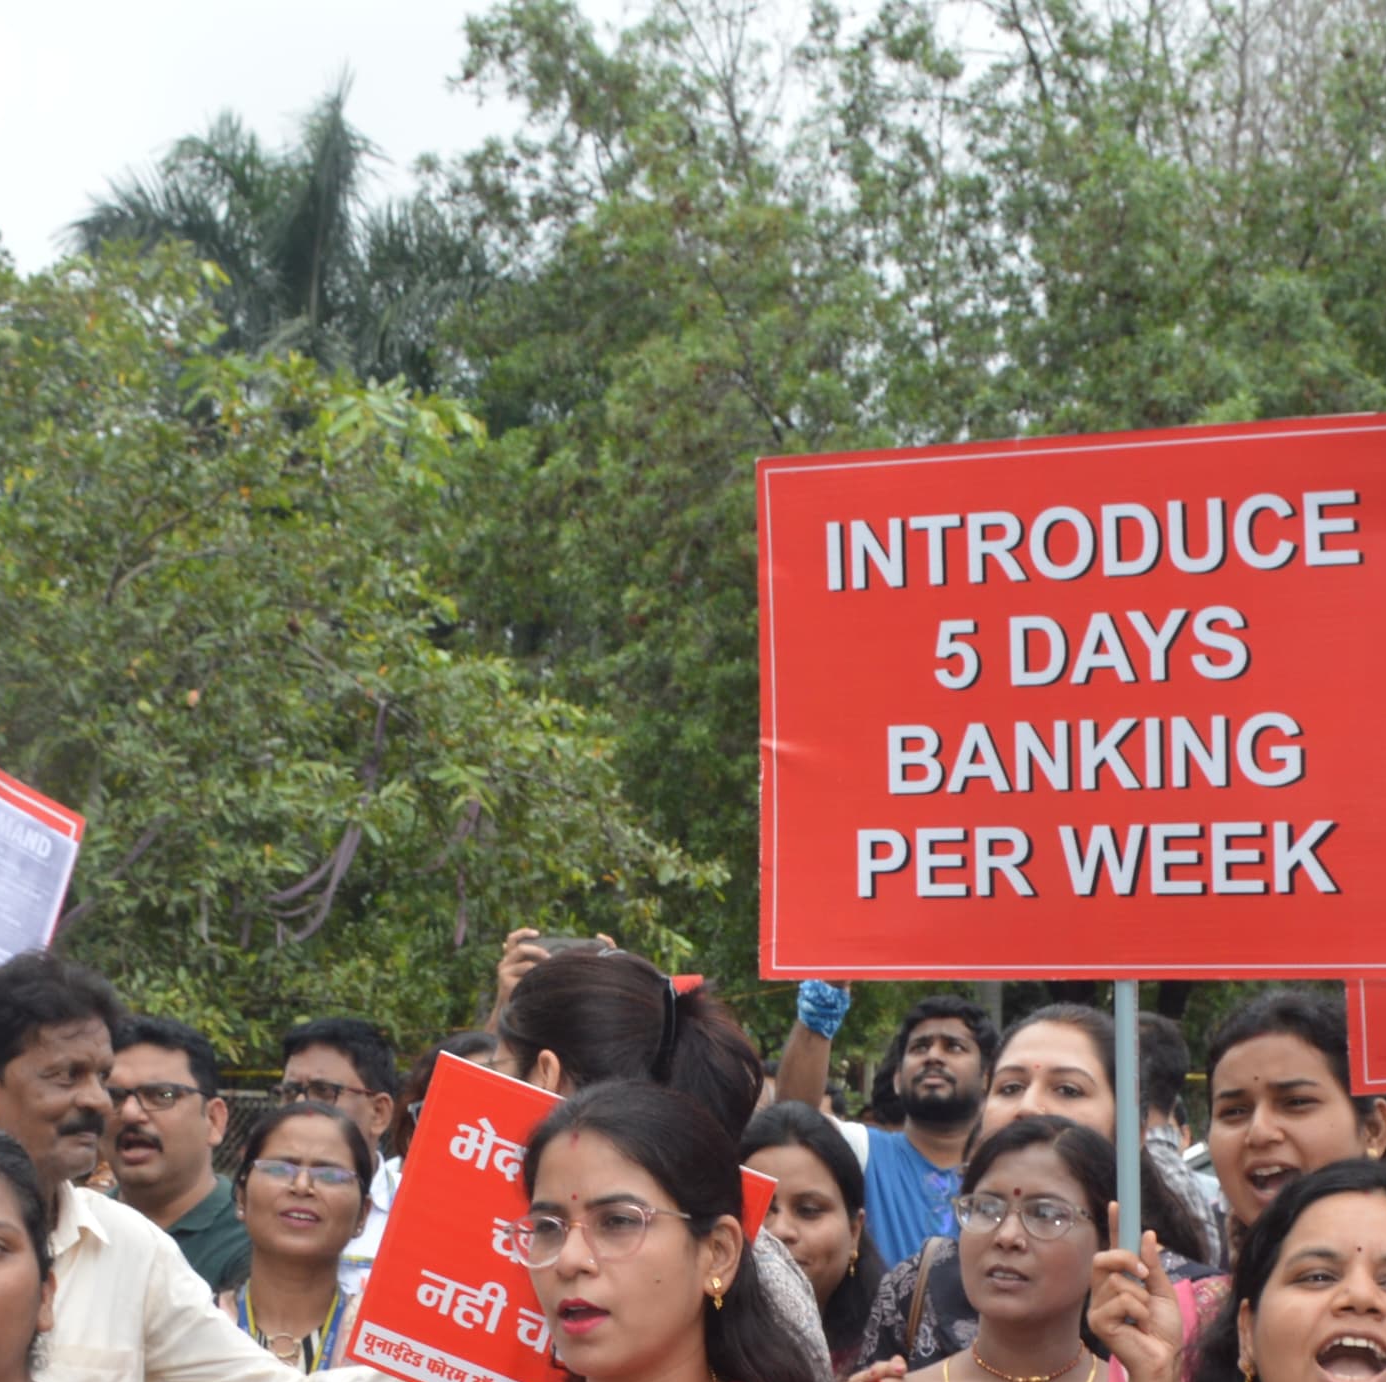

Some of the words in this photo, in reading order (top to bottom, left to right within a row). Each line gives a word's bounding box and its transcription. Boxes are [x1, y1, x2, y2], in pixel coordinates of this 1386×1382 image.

[825, 489, 1361, 591] INTRODUCE
[934, 619, 979, 689] 5
[1009, 605, 1249, 686] DAYS
[886, 711, 1303, 795] BANKING
[857, 826, 1035, 898] PER
[1058, 820, 1337, 896] WEEK
[449, 1117, 527, 1182] भेद
[416, 1269, 508, 1334] नही
